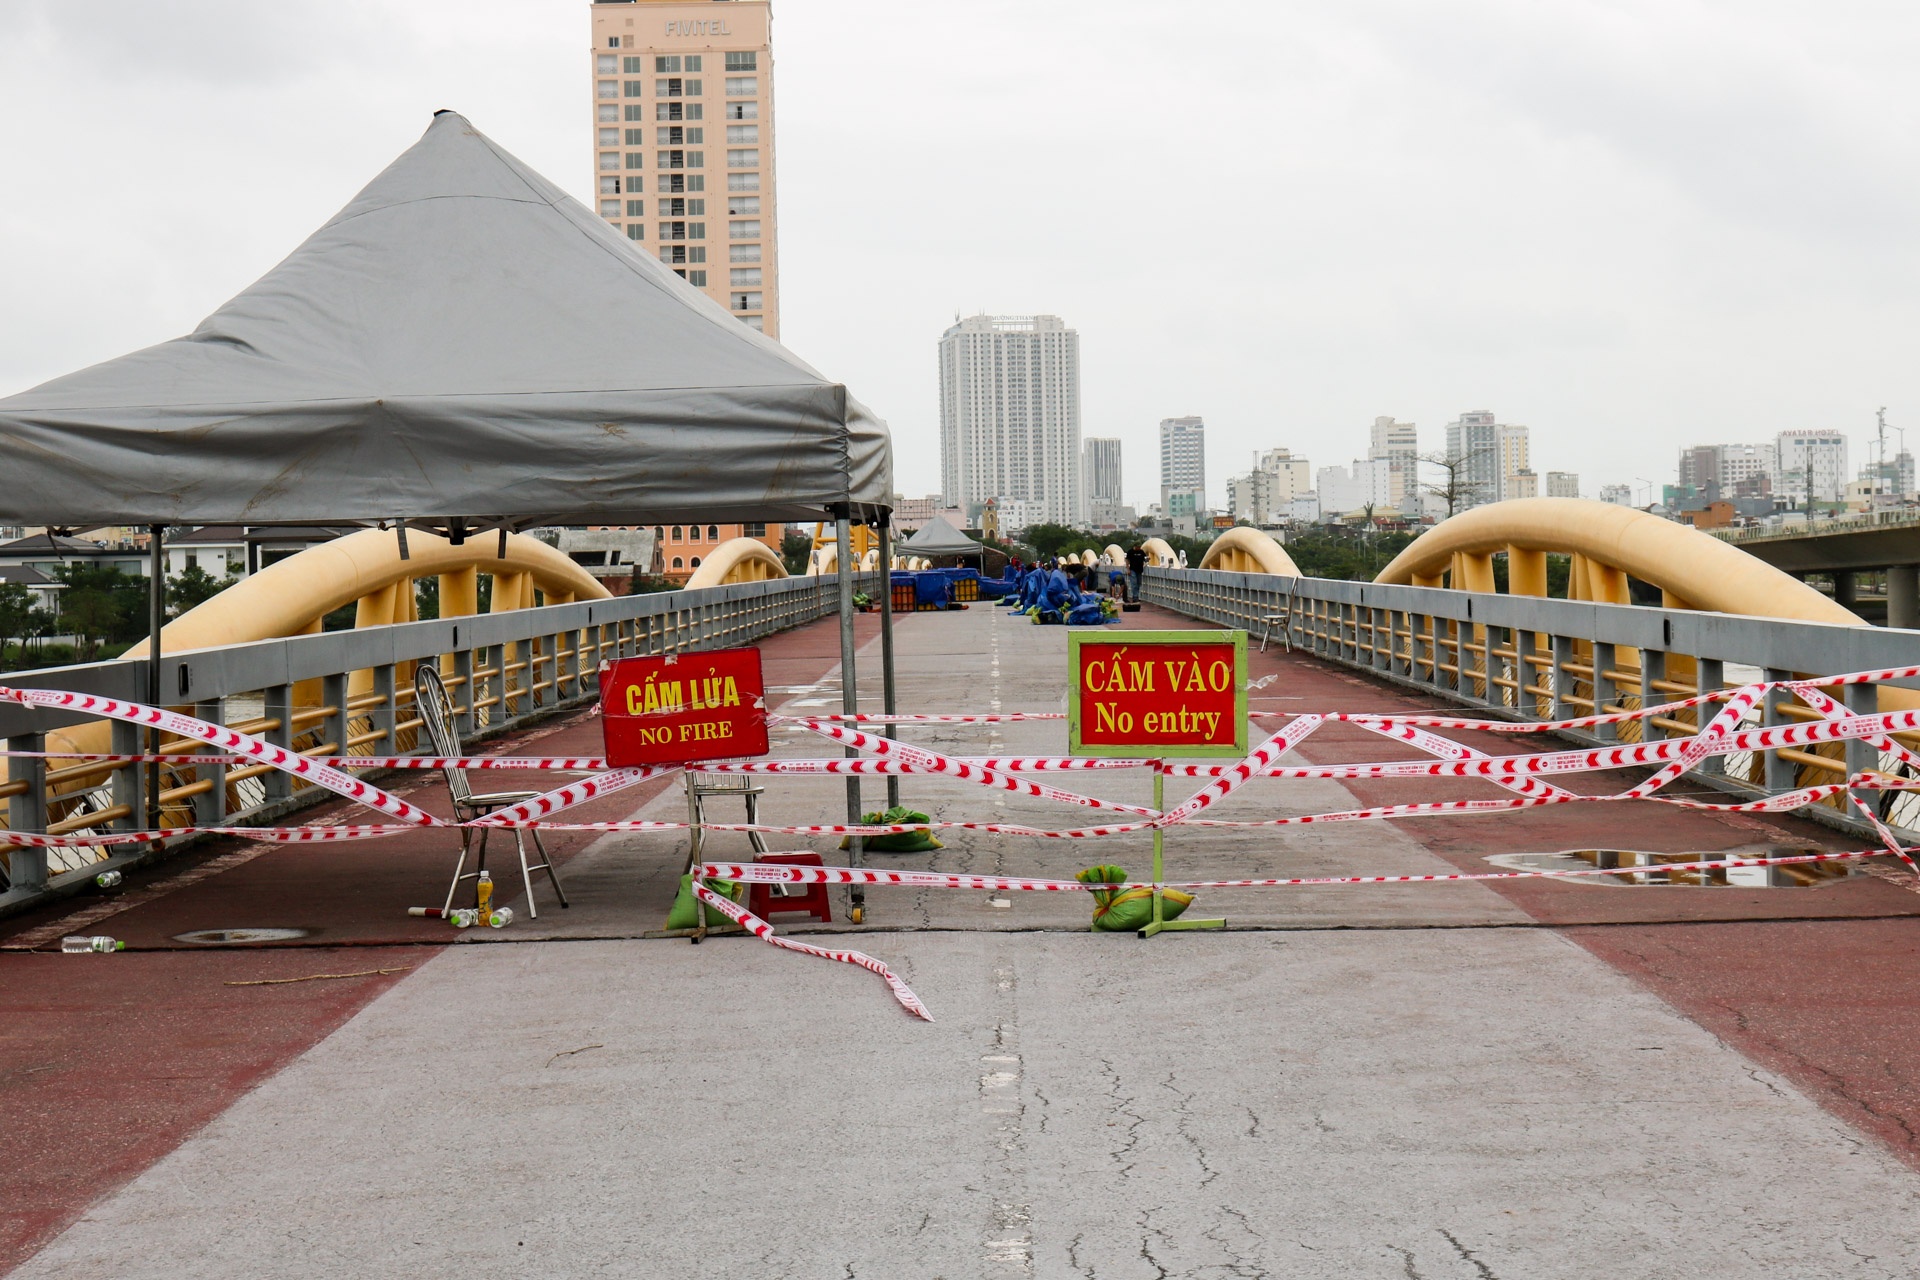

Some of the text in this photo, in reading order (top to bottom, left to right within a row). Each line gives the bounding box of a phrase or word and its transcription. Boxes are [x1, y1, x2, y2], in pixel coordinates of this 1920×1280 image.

[665, 19, 731, 36] FIVITEL
[1782, 429, 1813, 437] AVATAR
[1085, 646, 1230, 692] CẤM VÀO
[625, 667, 741, 716] CẤM LỬA
[639, 720, 733, 746] NO FIRE
[1094, 702, 1221, 740] No entry
